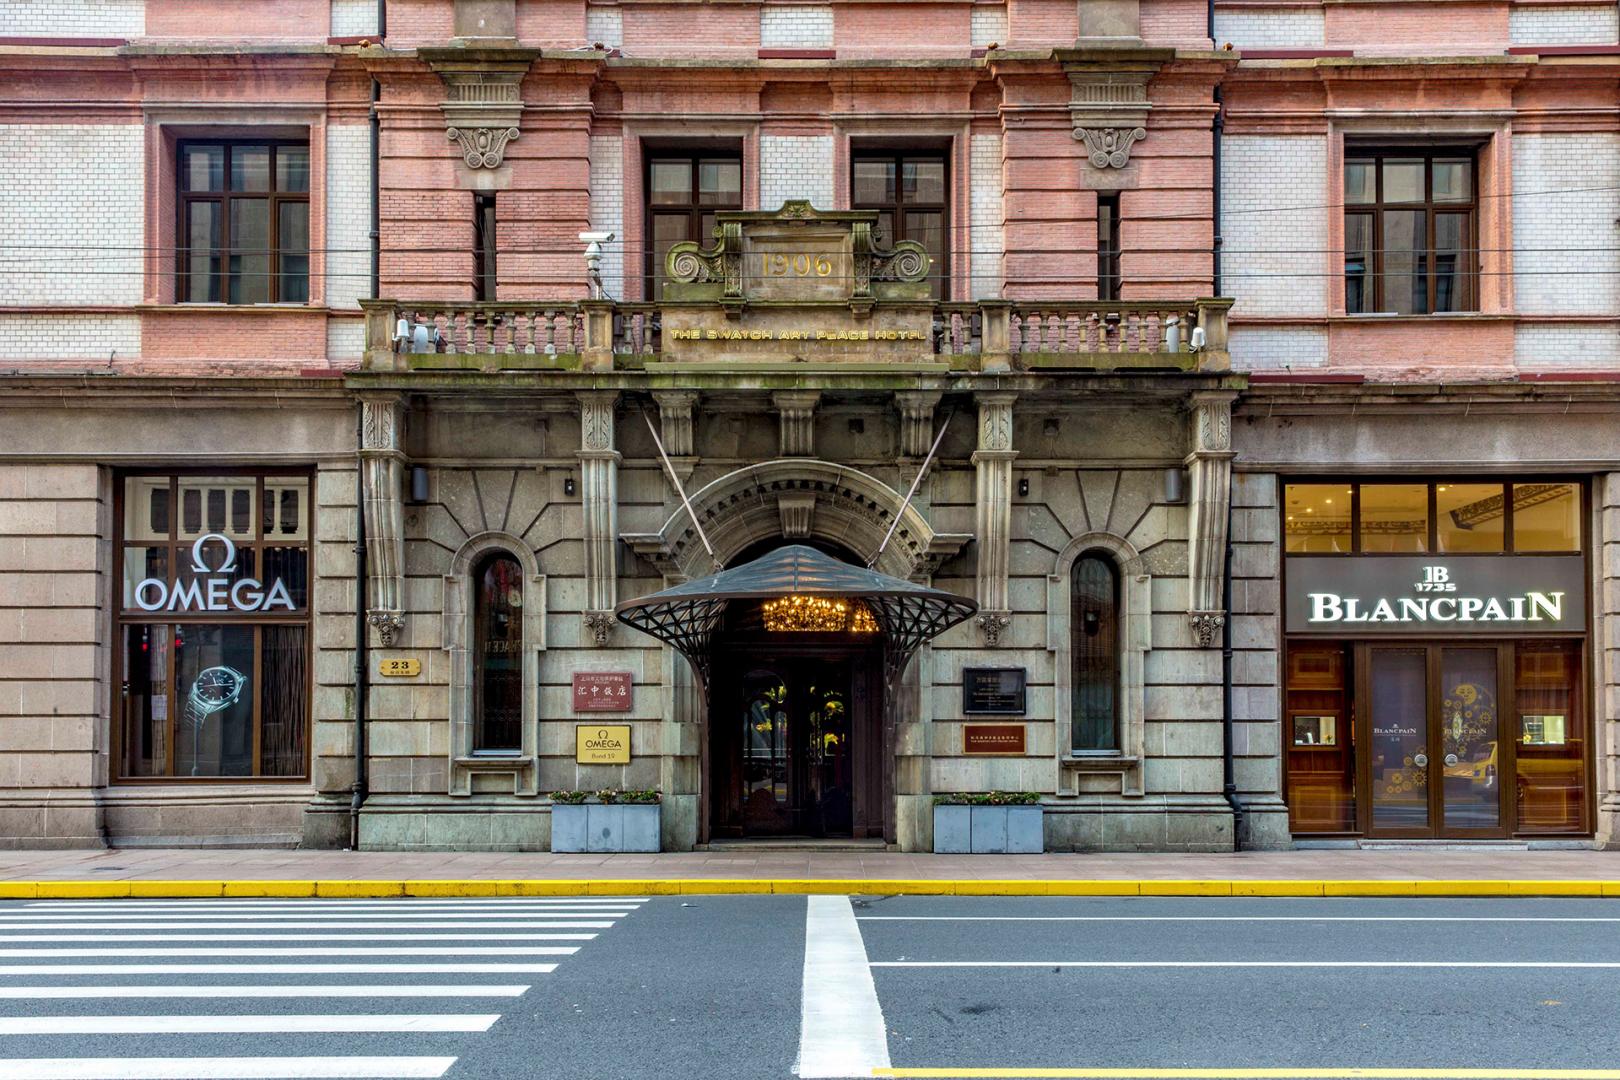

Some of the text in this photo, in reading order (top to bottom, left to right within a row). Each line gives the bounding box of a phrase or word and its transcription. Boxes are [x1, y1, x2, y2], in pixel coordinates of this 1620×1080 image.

[762, 251, 832, 277] 1906
[671, 329, 926, 340] THE SWATCH ART PEACE HOTEL
[1414, 583, 1457, 592] 1735
[135, 576, 296, 612] OMEGA
[1307, 591, 1566, 624] BLANCPAIN
[391, 661, 409, 670] 23
[585, 740, 622, 748] OMEGA
